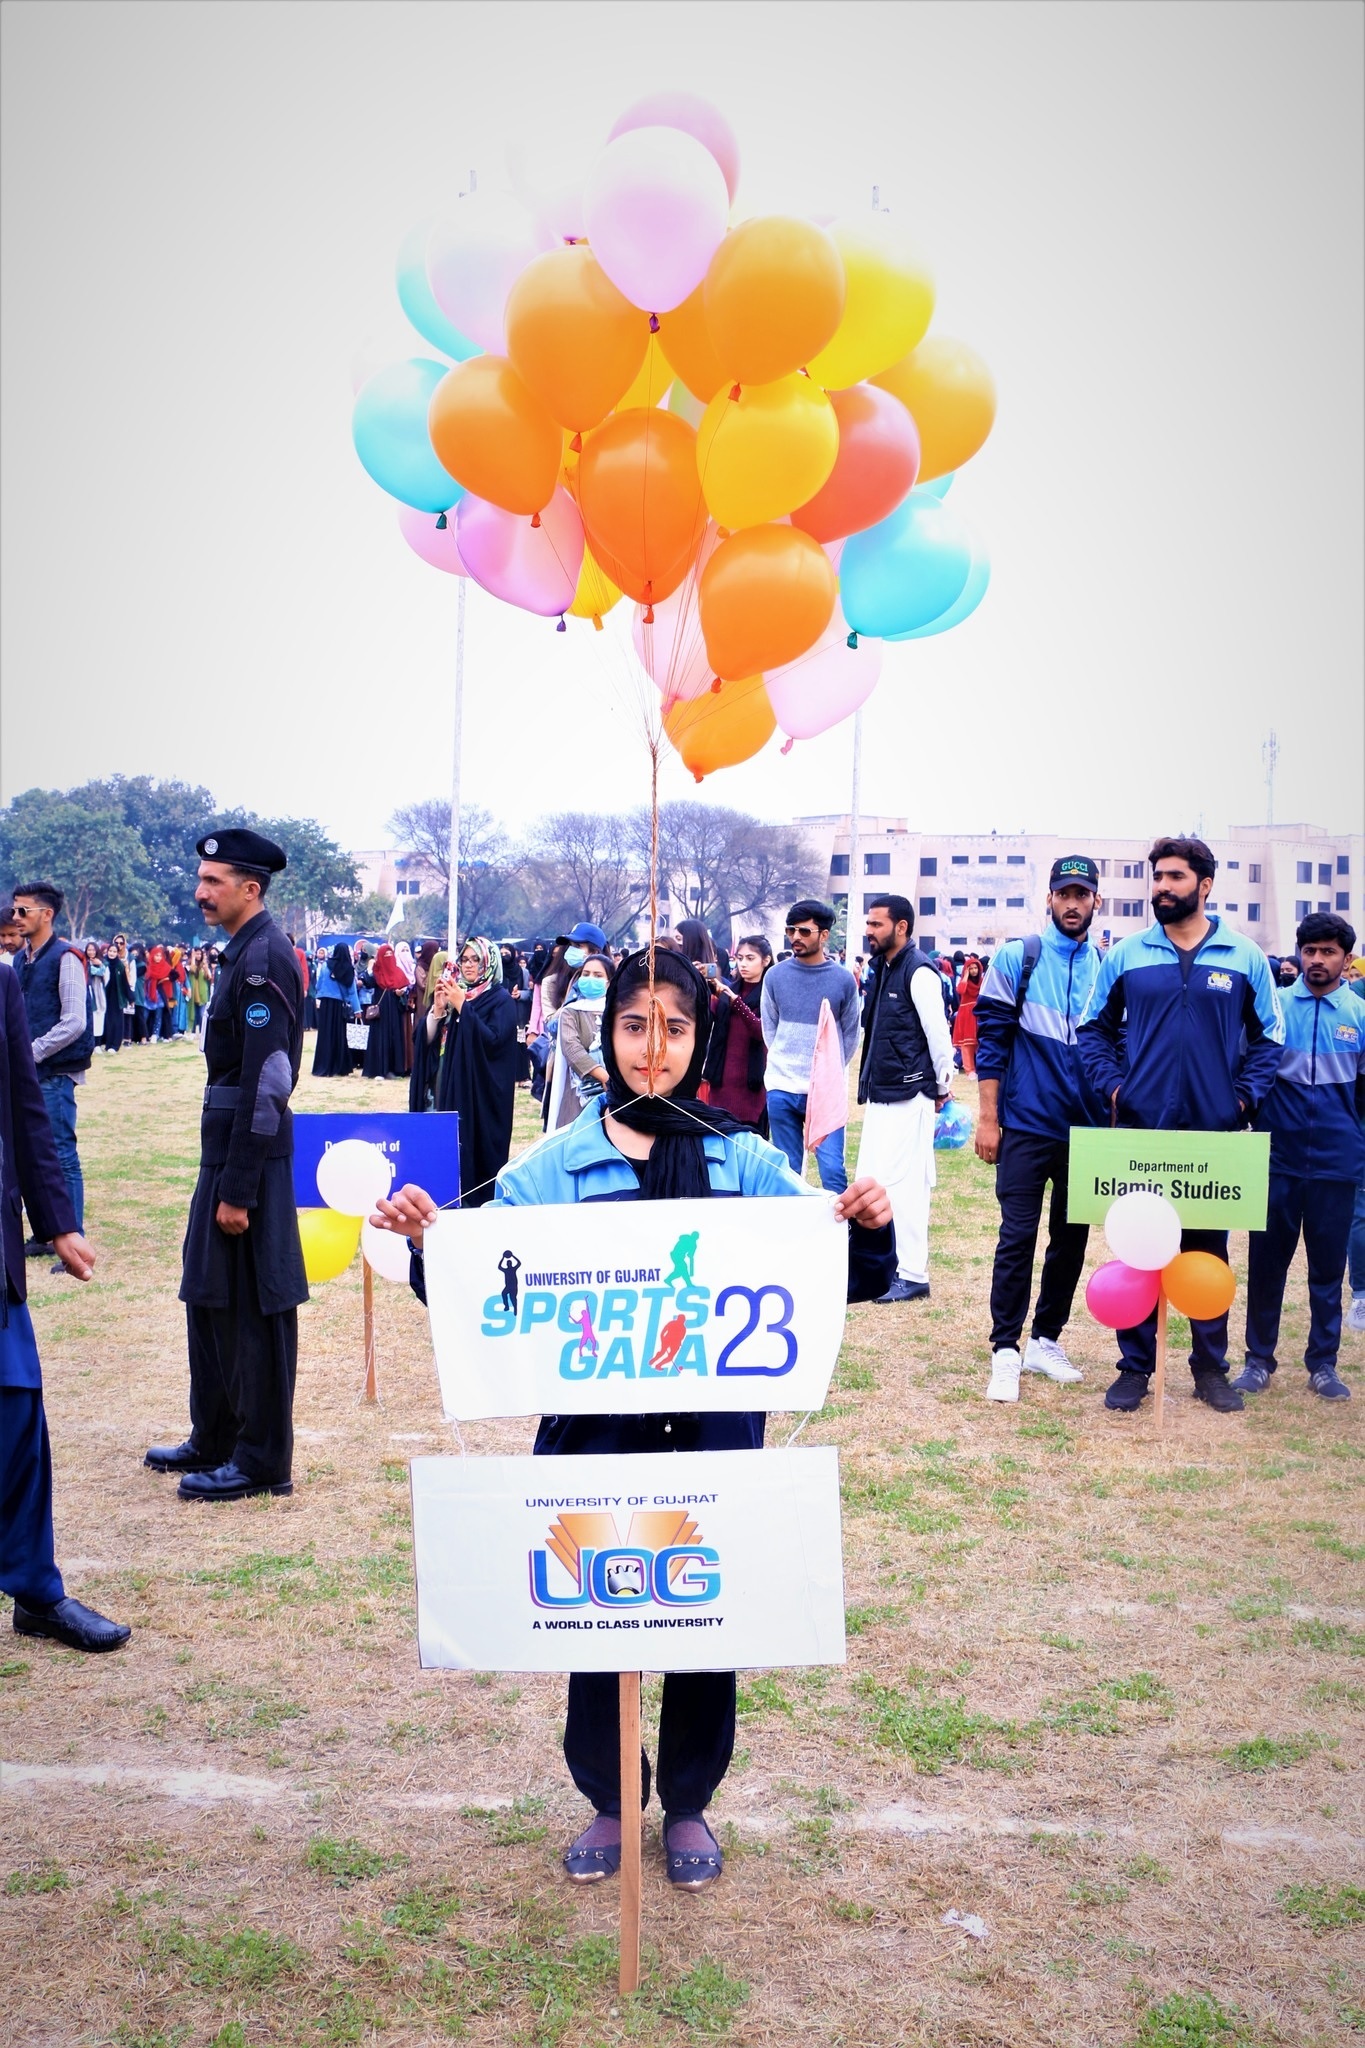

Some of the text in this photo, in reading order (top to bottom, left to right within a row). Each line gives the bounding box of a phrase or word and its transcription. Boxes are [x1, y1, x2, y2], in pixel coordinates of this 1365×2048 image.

[1061, 861, 1088, 871] GUCCI
[389, 1140, 400, 1152] of
[1129, 1160, 1209, 1174] Department of
[1094, 1177, 1242, 1201] Islamic Studies
[525, 1268, 661, 1287] UNIVERSITY OF GUJRAT
[480, 1286, 711, 1338] SPORTS
[714, 1284, 798, 1378] 23
[558, 1334, 708, 1381] GALA
[525, 1493, 719, 1508] UNIVERSITY OF GUJRAT
[528, 1545, 721, 1610] UOG
[532, 1617, 724, 1630] A WORLD CLASS UNIVERSITY
